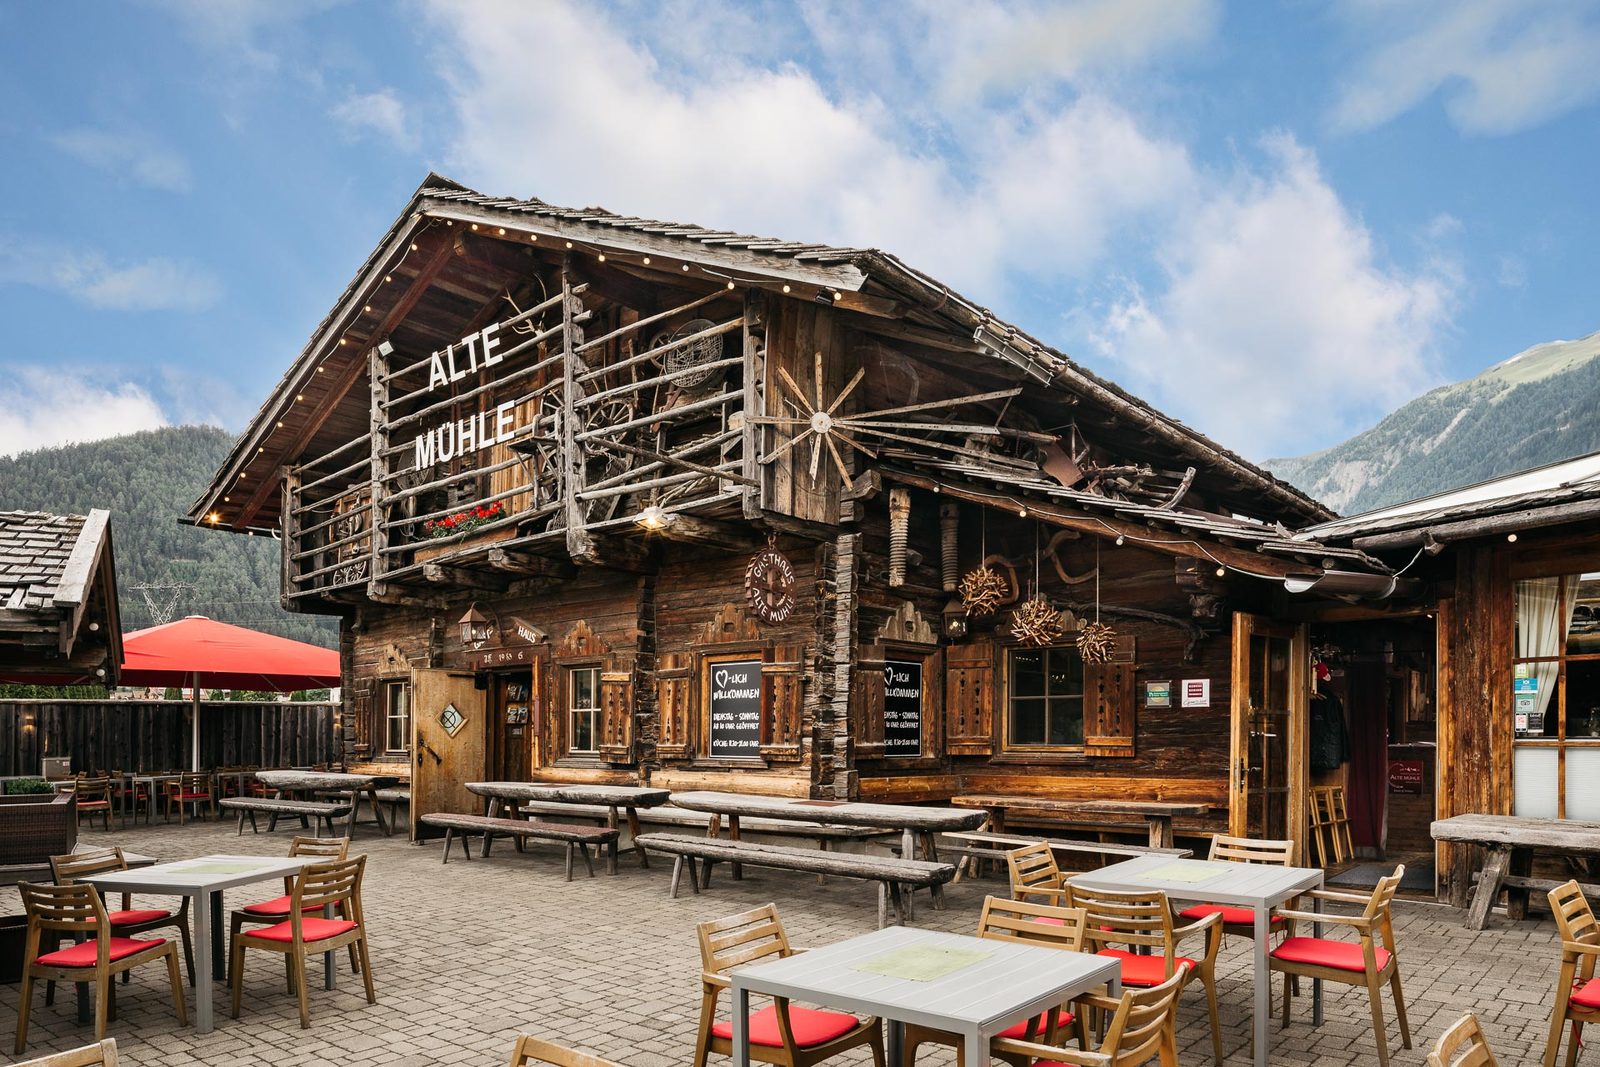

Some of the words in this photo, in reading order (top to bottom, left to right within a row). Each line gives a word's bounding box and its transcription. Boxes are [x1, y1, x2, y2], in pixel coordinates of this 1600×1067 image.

[429, 322, 503, 391] ALTE
[415, 399, 516, 471] MÜHLE
[753, 553, 795, 584] GASTHAUS
[752, 587, 768, 617] ALTE
[517, 625, 537, 644] HAUS
[713, 688, 759, 700] WILLKOMMEN
